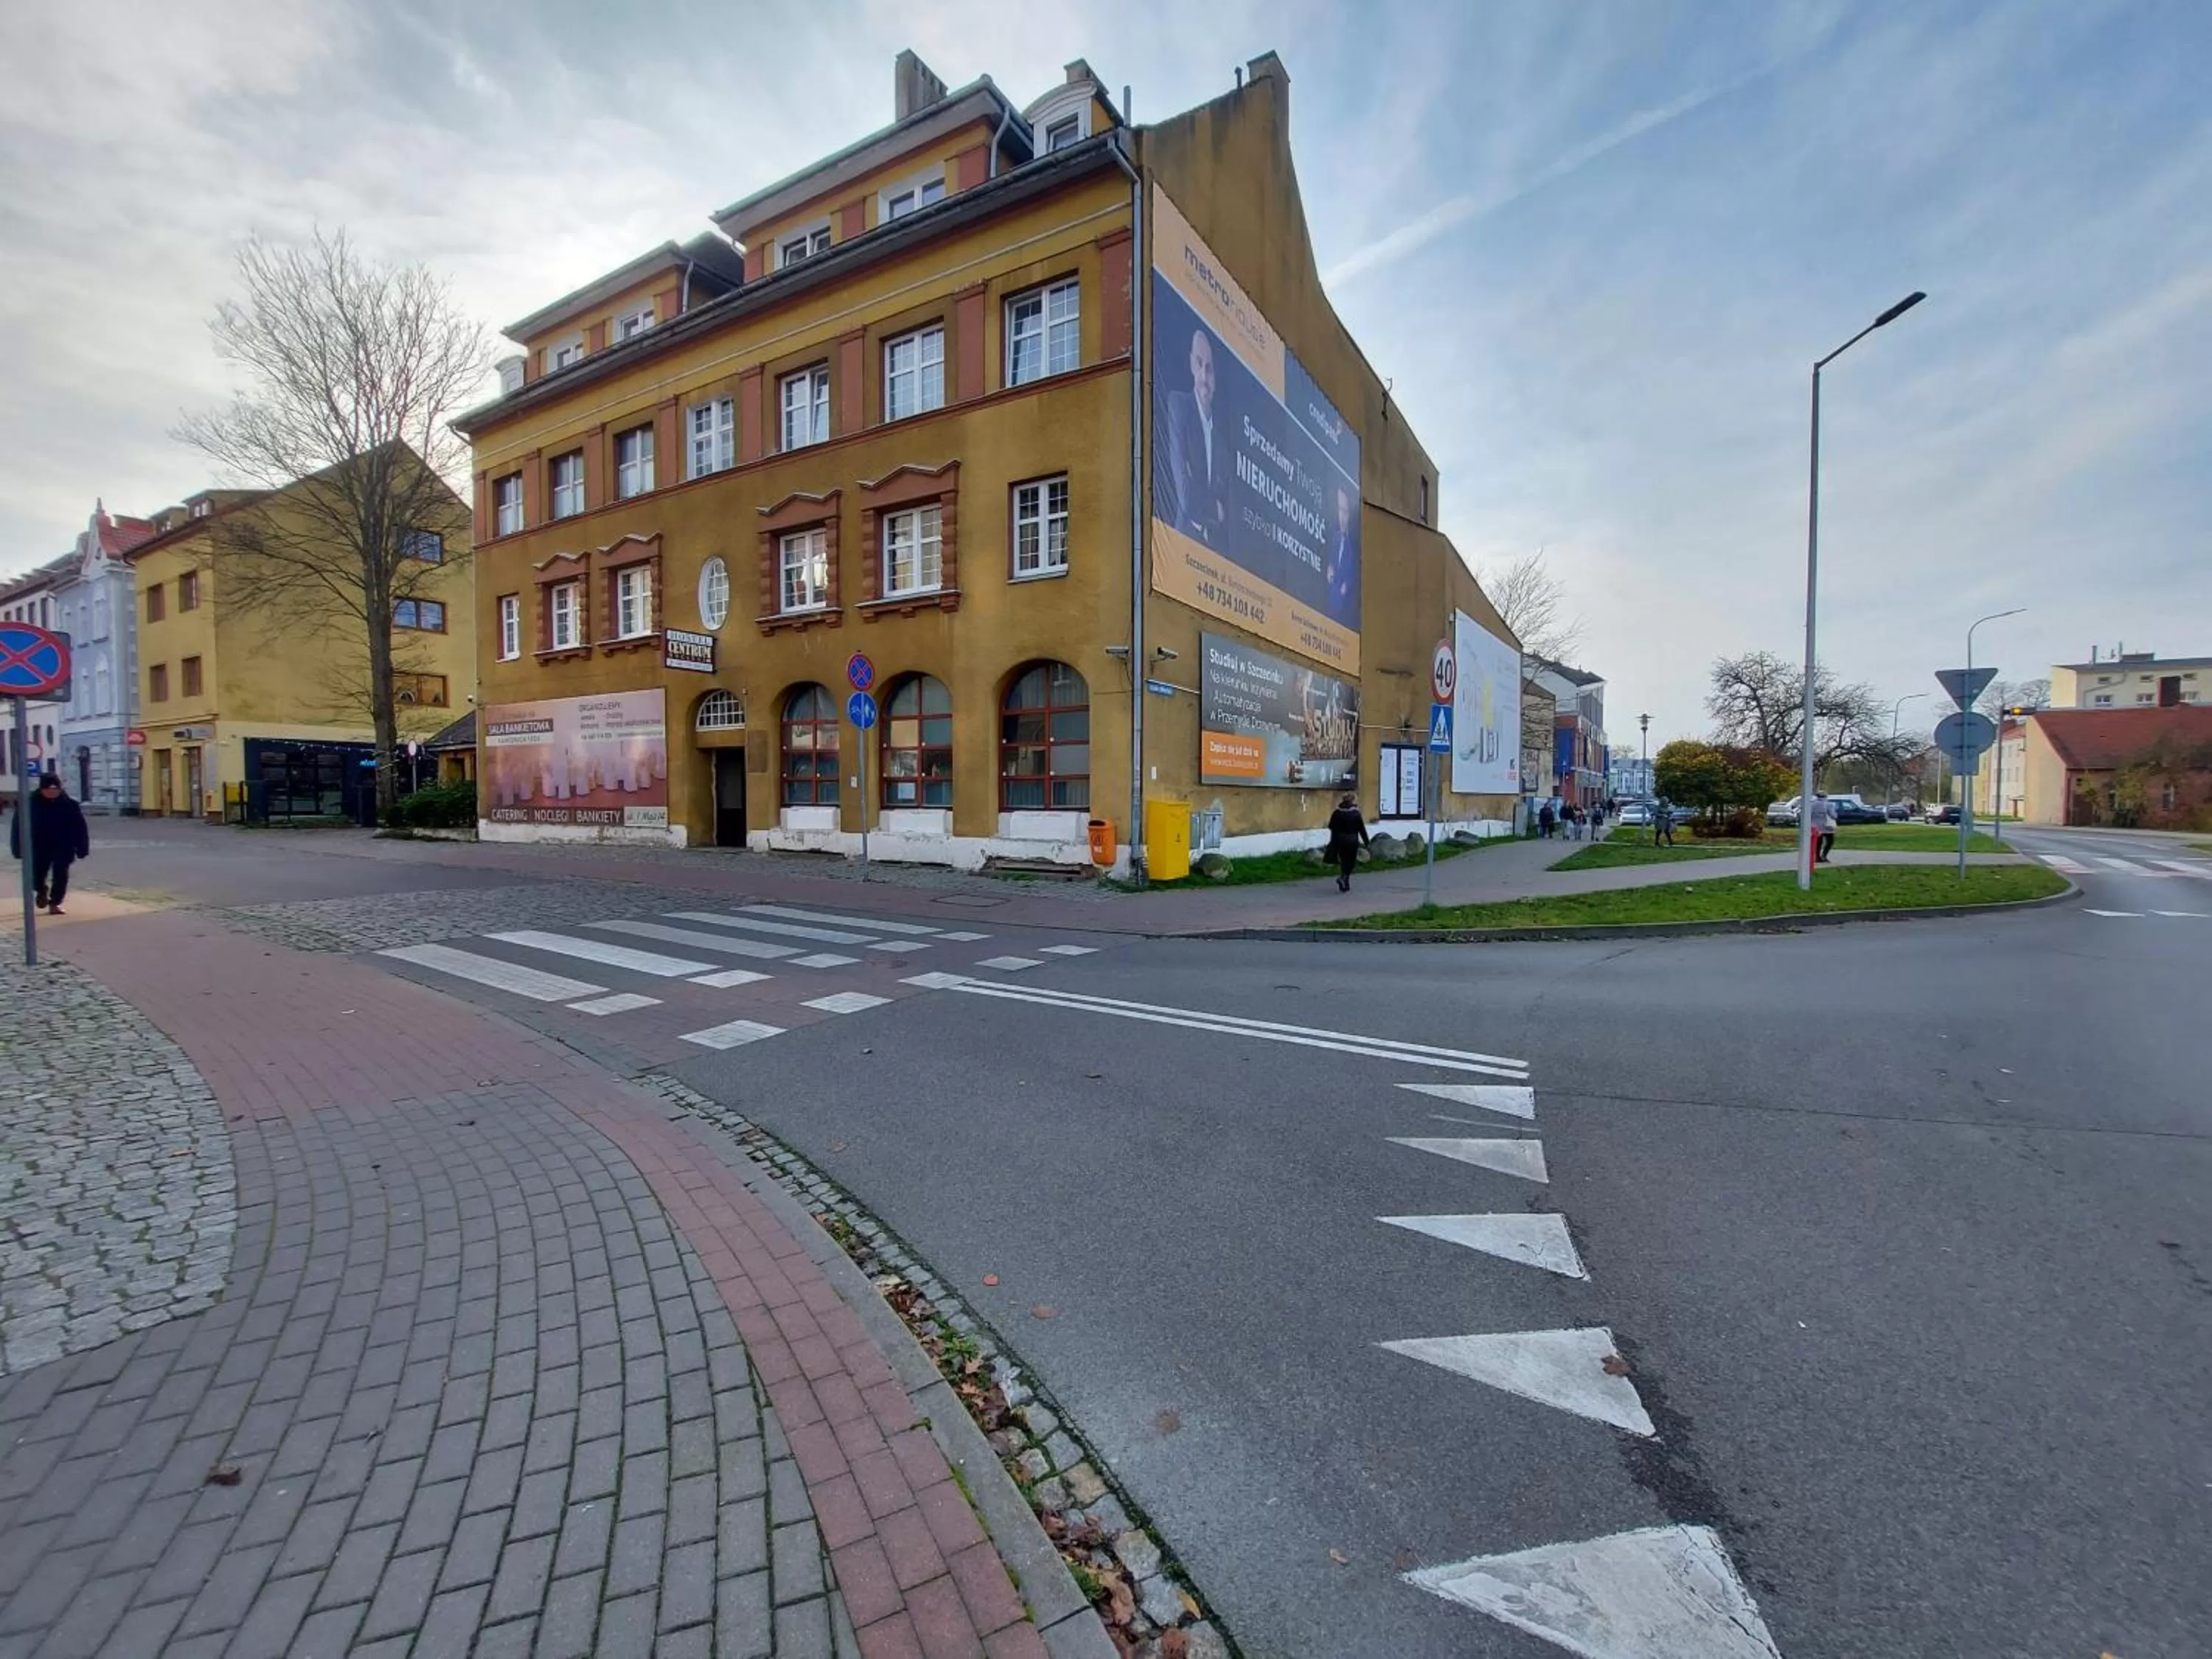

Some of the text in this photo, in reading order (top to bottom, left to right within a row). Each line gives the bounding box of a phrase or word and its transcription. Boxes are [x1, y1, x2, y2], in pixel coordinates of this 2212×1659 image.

[1244, 414, 1295, 481] Sprzedamy
[1237, 450, 1326, 543] NIERUCHOMOŚĆ
[1276, 526, 1321, 573] KORZYSTNIE
[1197, 581, 1214, 602] +48
[1216, 588, 1232, 608] 734
[669, 641, 712, 658] CENTRUM
[1209, 648, 1238, 672] Studiuj
[1436, 657, 1453, 688] 40
[492, 809, 621, 824] CATERING NOCLEG BANKIETY
